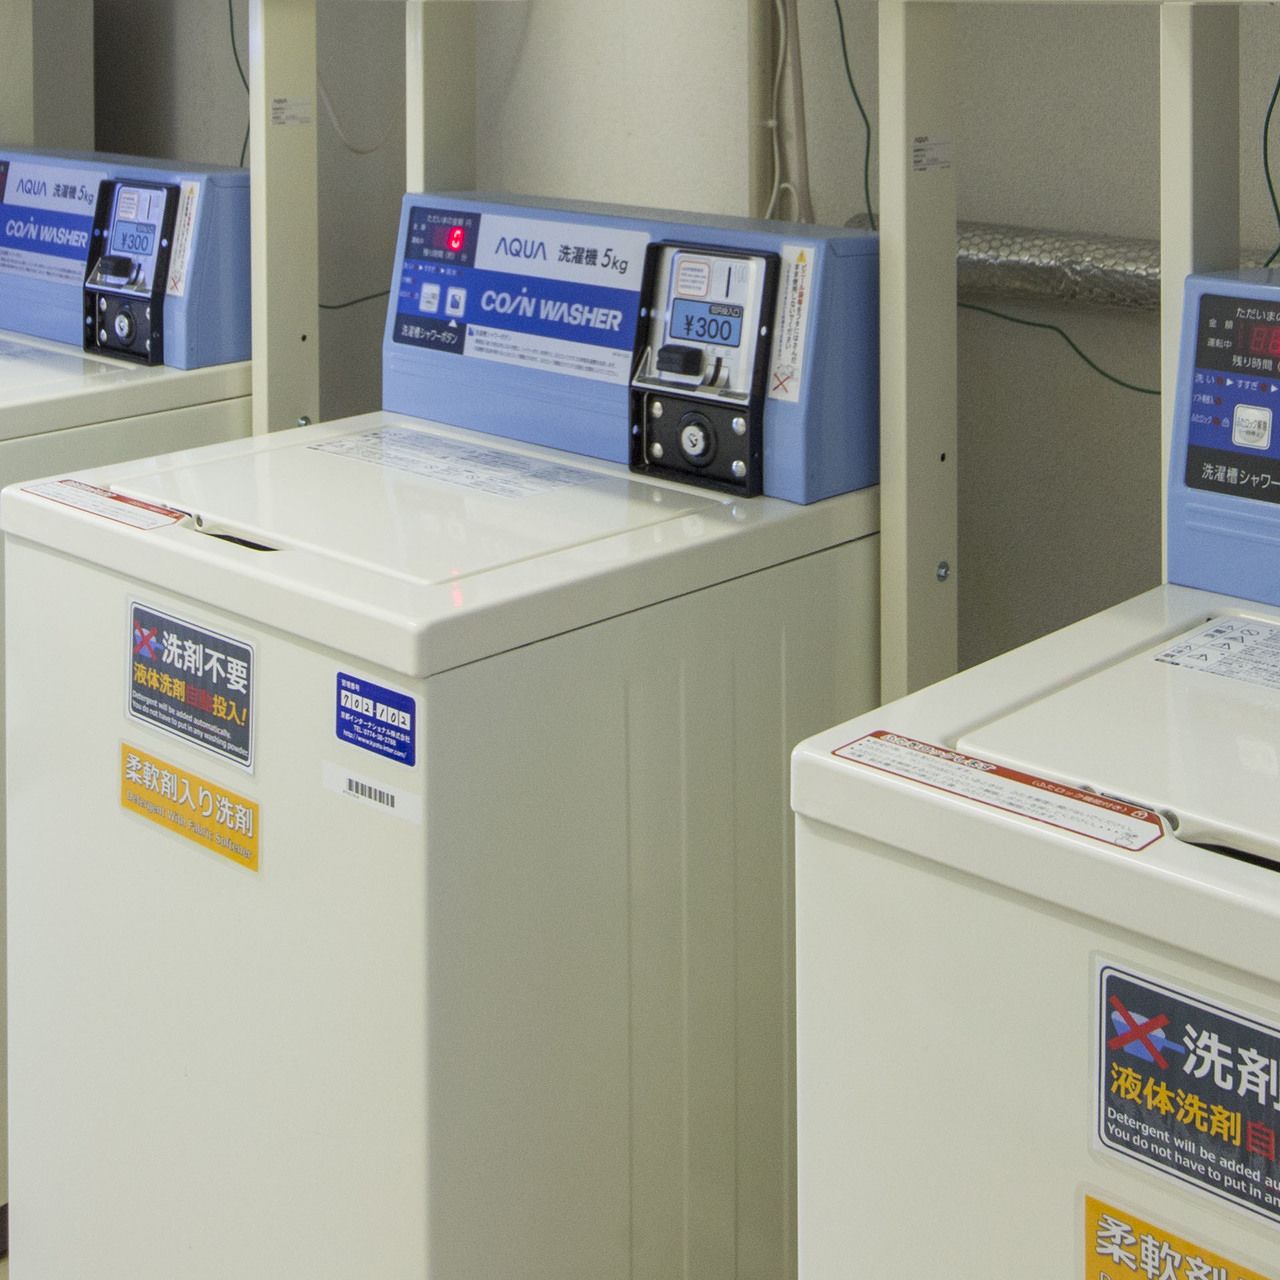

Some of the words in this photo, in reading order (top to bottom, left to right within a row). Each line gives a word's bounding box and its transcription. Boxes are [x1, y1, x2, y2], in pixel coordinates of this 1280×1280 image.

[17, 179, 47, 197] AQUA
[52, 183, 76, 200] 洗濯機
[77, 185, 95, 205] 5kg
[6, 217, 37, 238] COIN
[40, 226, 89, 249] WASHER
[121, 235, 149, 251] ¥300
[495, 237, 547, 260] AQUA
[558, 245, 597, 267] 洗濯機
[601, 249, 629, 274] 5kg
[481, 287, 536, 317] COIN
[540, 302, 623, 332] WASHER
[684, 314, 732, 341] ¥300
[1194, 373, 1215, 385] 洗い
[1236, 380, 1258, 391] すすぎ
[162, 630, 248, 694] 洗剤不要
[134, 661, 247, 726] 液体洗剤自動投入!
[176, 710, 193, 722] added
[344, 694, 407, 726] 702-102
[204, 732, 227, 749] washing
[126, 752, 253, 837] 柔軟剤入り洗剤
[215, 833, 252, 859] Softener
[1107, 1106, 1170, 1143] Detergent
[1173, 1134, 1195, 1155] will
[1199, 1144, 1216, 1162] be
[1219, 1155, 1261, 1183] added
[1107, 1123, 1130, 1143] You
[1132, 1132, 1148, 1150] do
[1151, 1141, 1172, 1161] not
[1174, 1150, 1206, 1175] have
[1208, 1164, 1221, 1181] to
[1224, 1174, 1247, 1197] put
[1249, 1182, 1262, 1200] in
